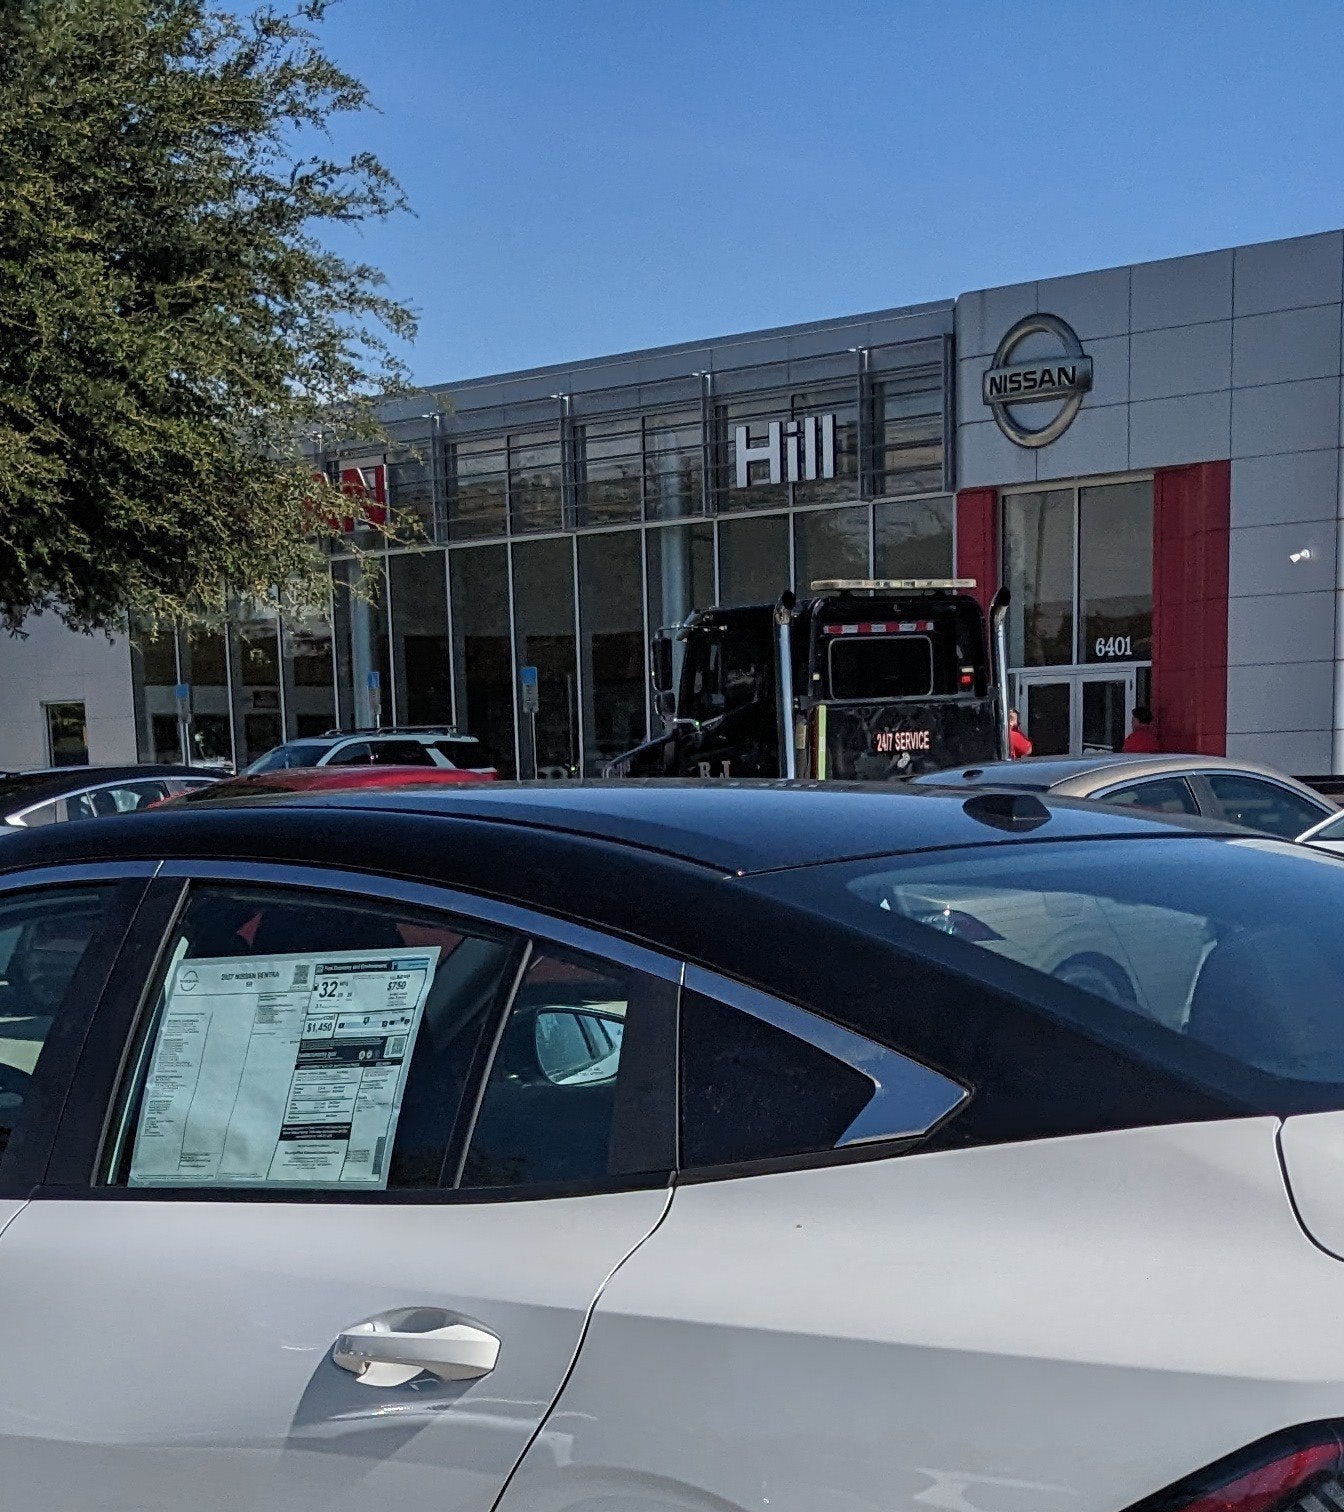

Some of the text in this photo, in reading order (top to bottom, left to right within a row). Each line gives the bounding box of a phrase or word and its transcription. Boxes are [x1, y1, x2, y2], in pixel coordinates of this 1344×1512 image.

[990, 366, 1076, 396] NISSAN
[736, 414, 836, 488] Hill
[1096, 636, 1132, 657] 6401
[895, 731, 930, 750] SERVICE
[318, 980, 338, 998] 32
[387, 980, 407, 991] $750
